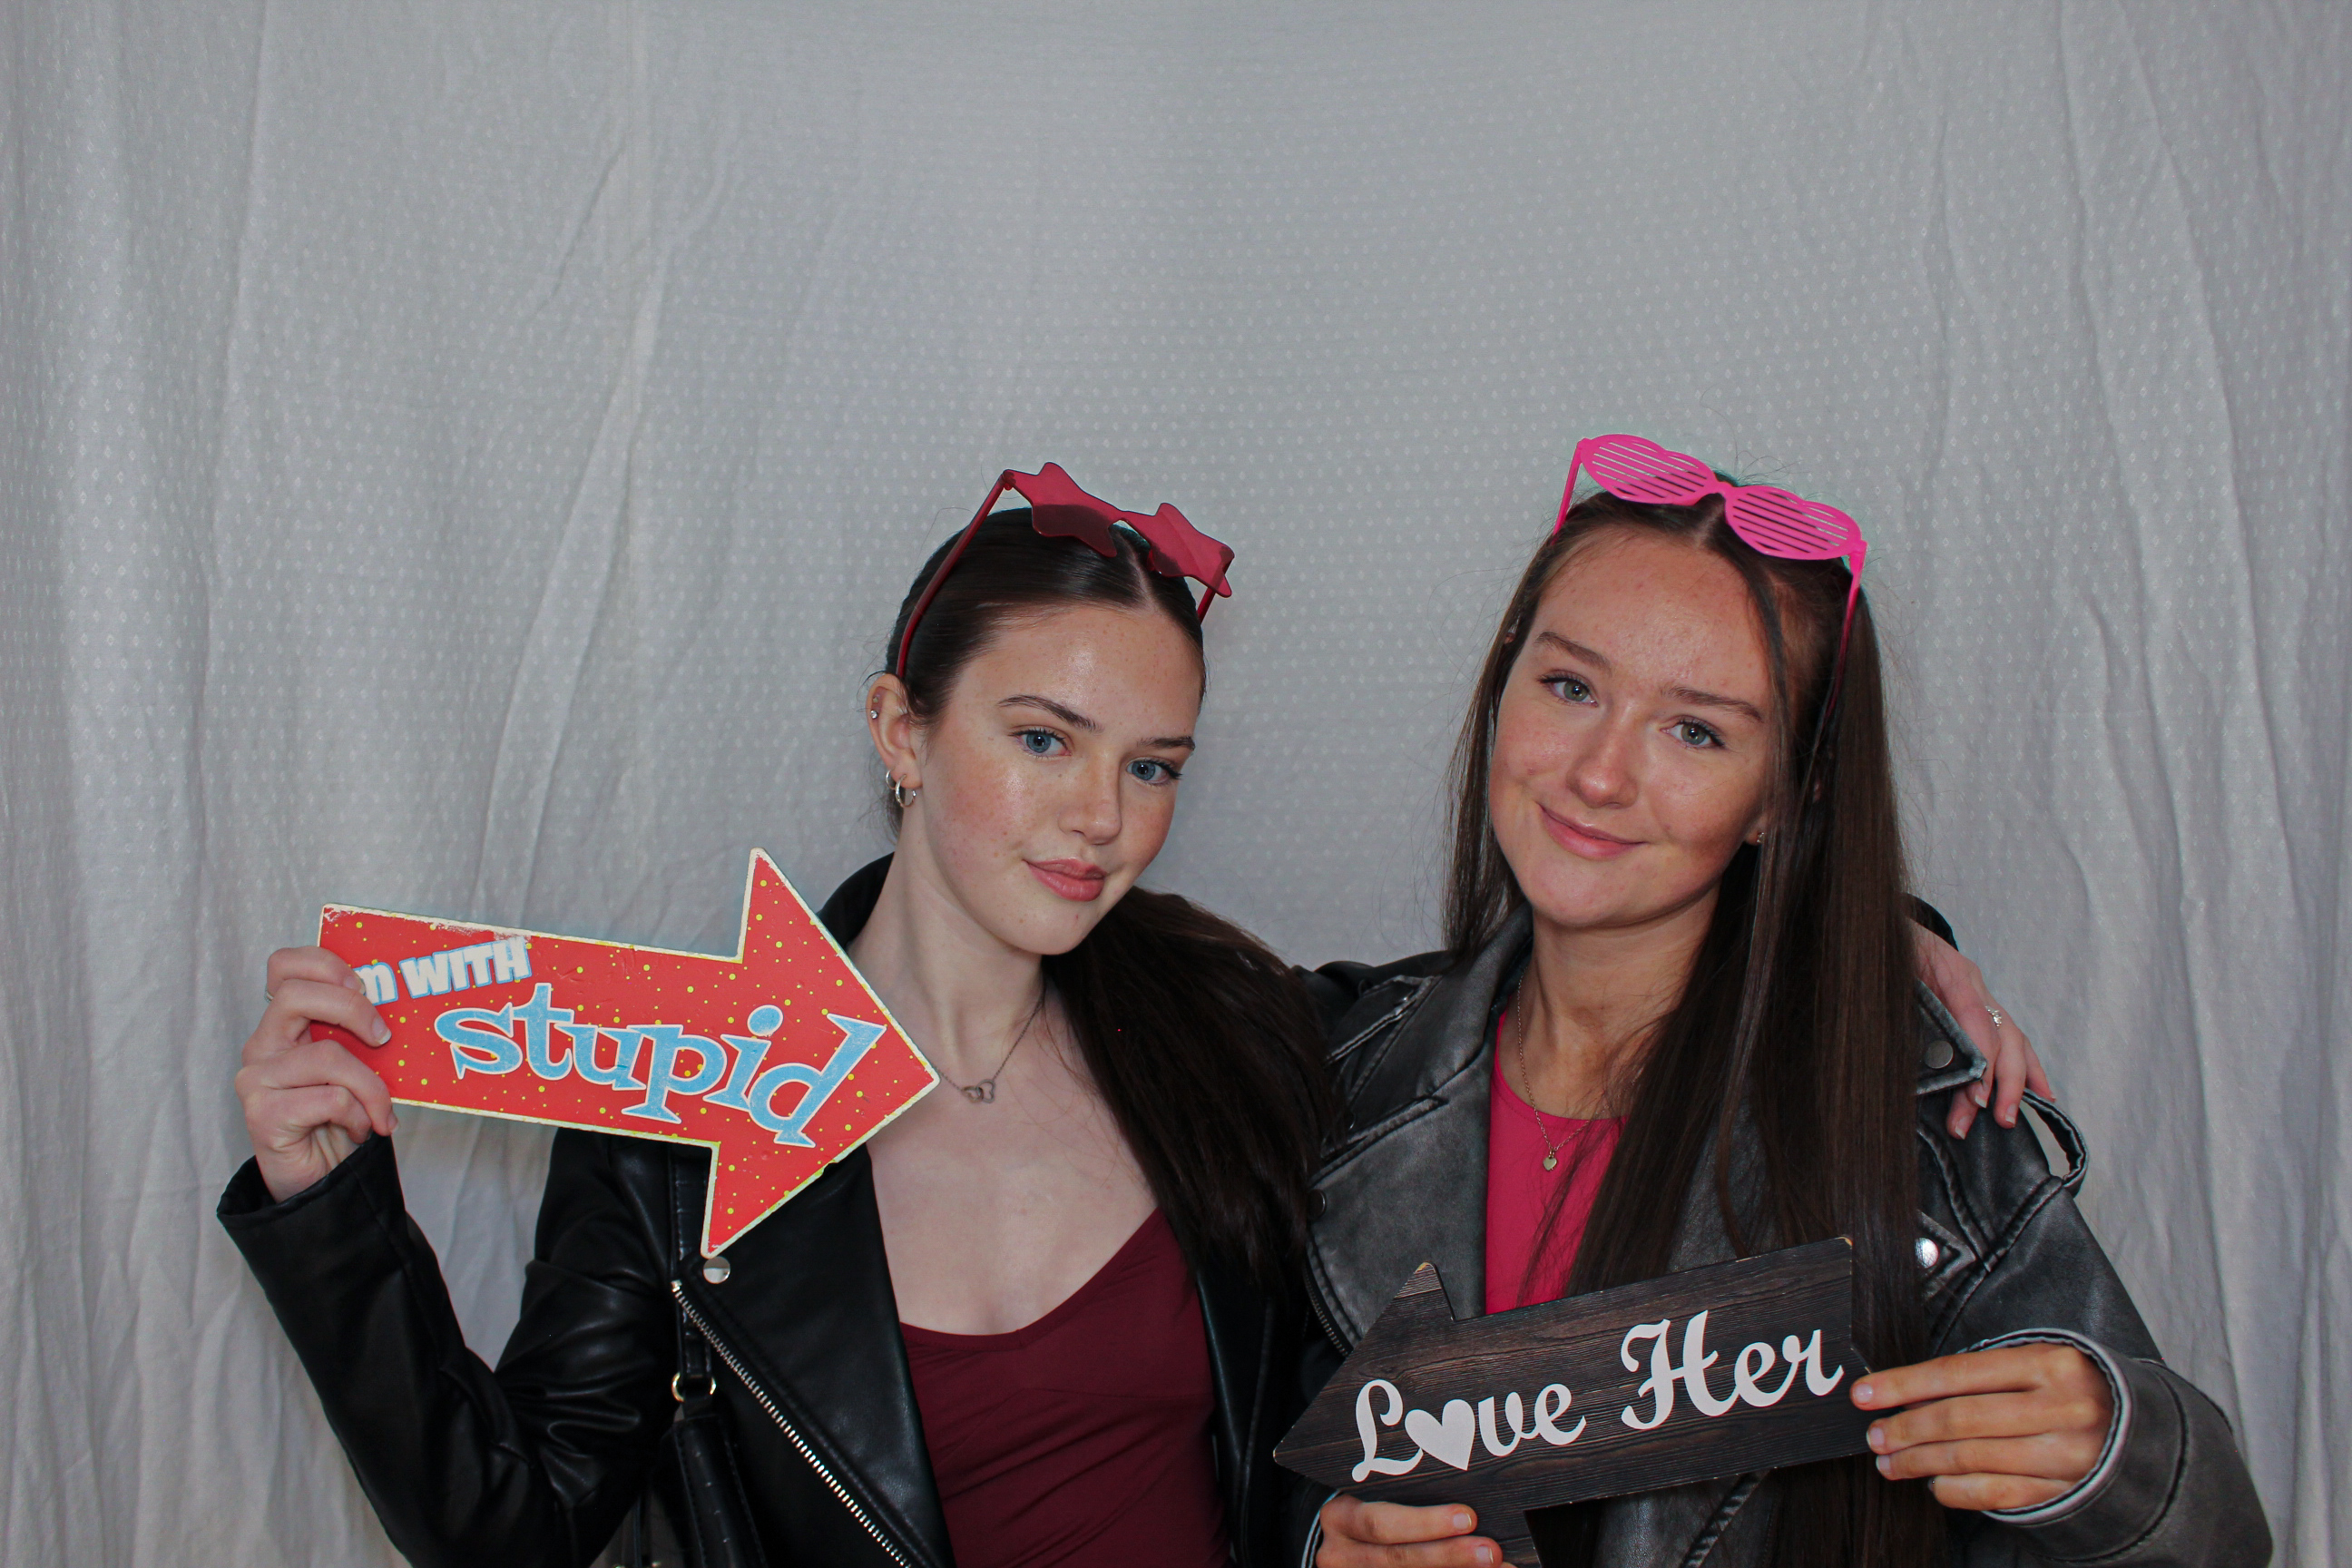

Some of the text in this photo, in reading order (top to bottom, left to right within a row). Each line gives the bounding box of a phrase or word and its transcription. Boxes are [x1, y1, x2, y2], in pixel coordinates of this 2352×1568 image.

[398, 936, 533, 999] WITH
[435, 983, 887, 1148] stupid
[1621, 1309, 1845, 1430] Her
